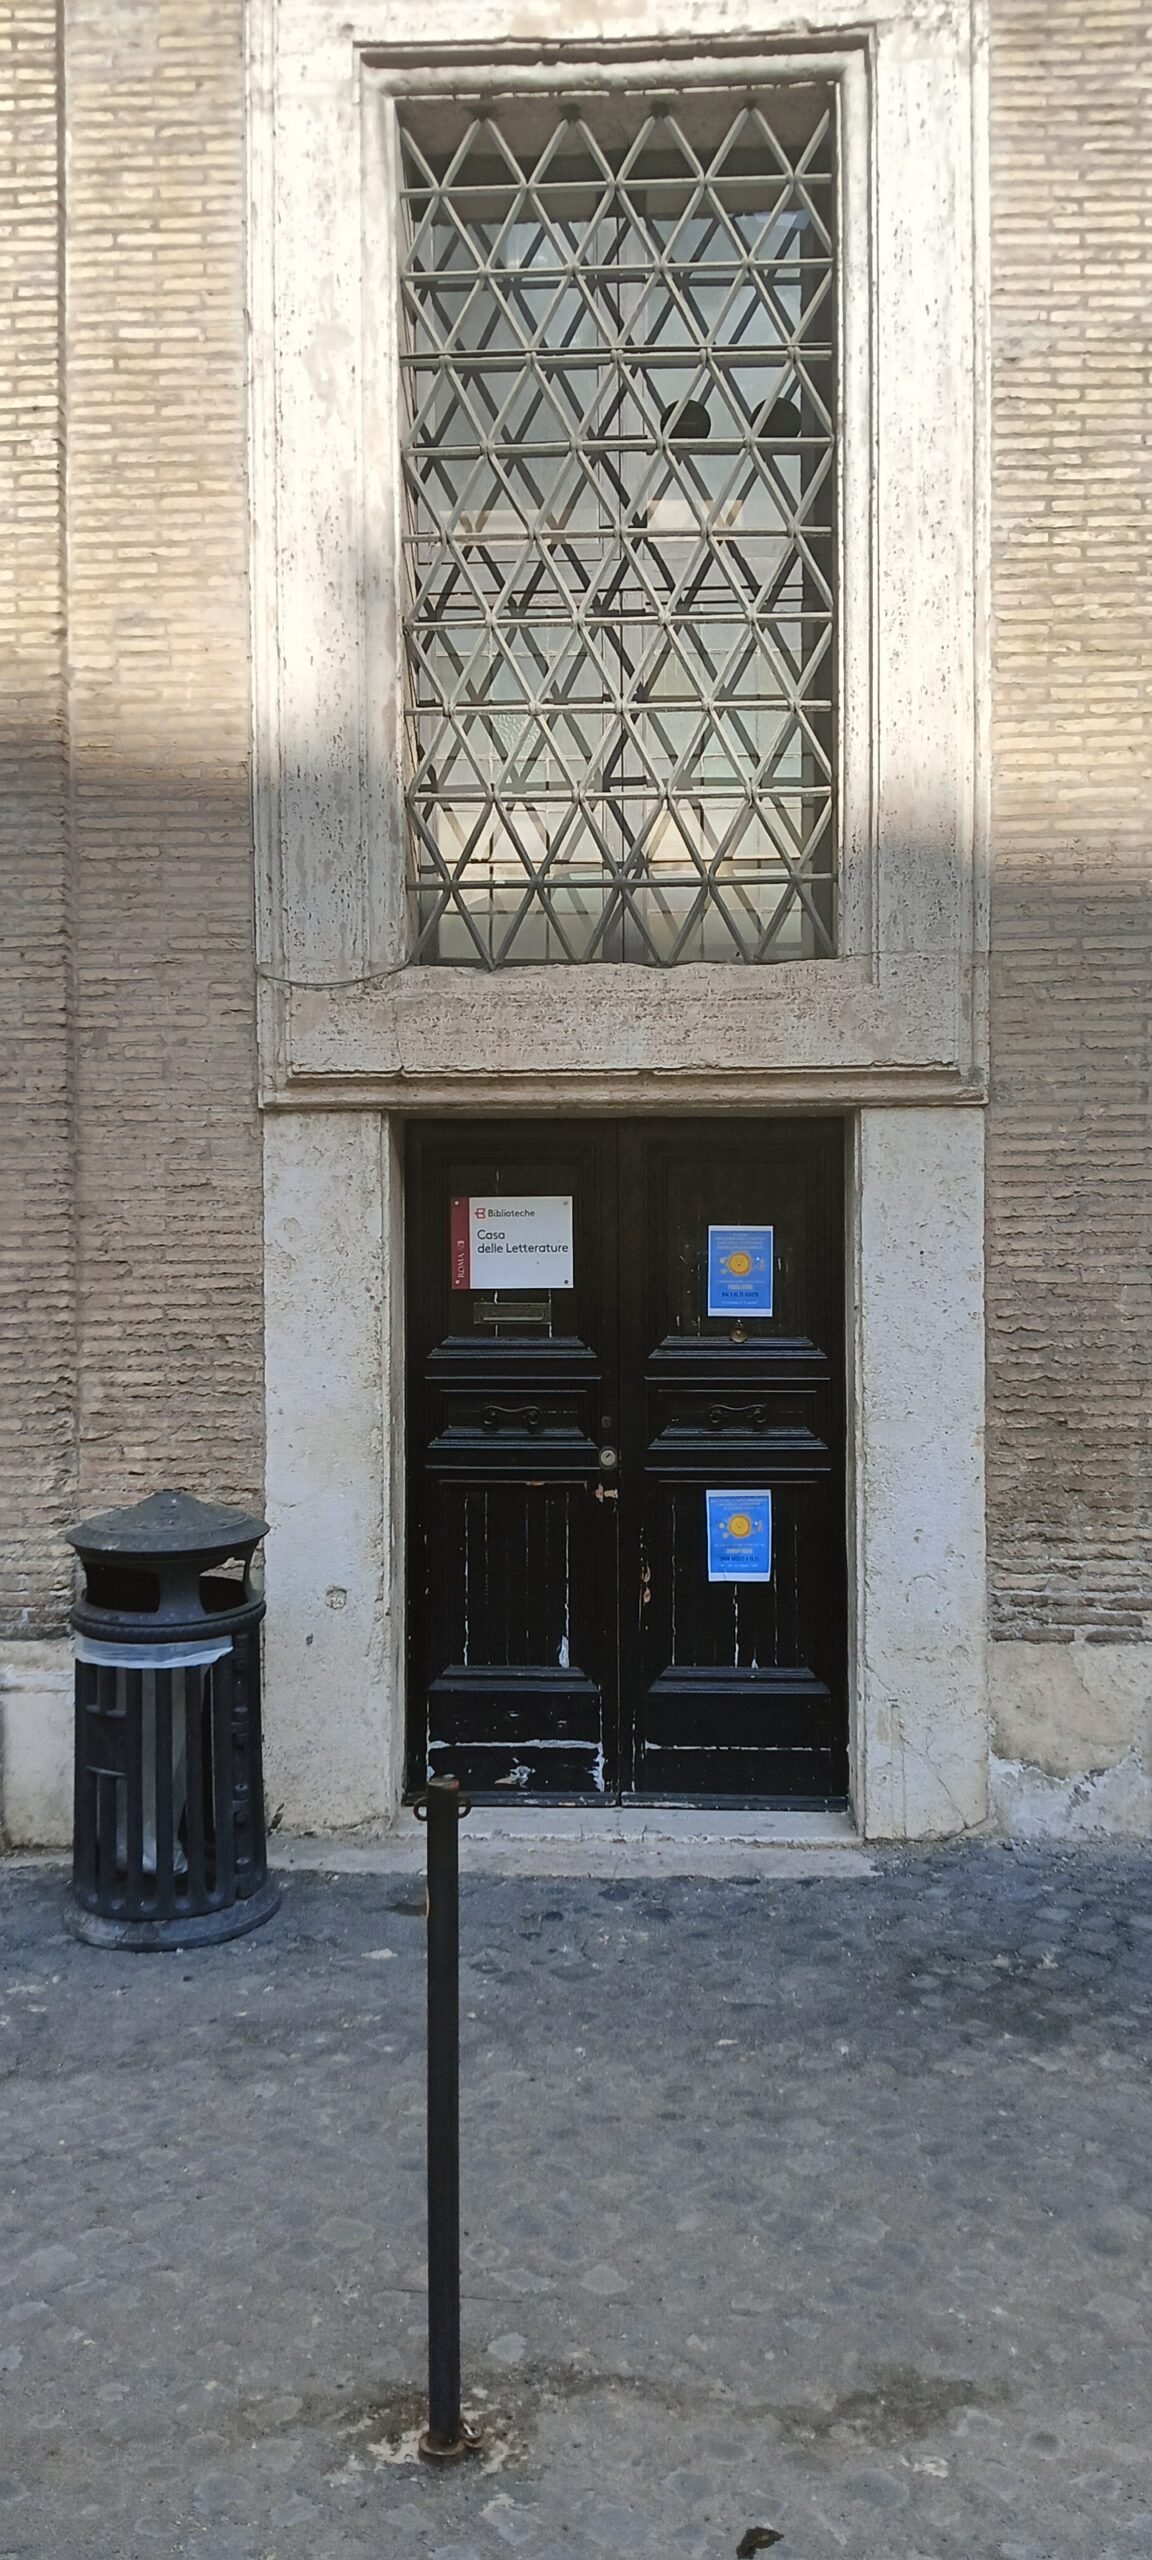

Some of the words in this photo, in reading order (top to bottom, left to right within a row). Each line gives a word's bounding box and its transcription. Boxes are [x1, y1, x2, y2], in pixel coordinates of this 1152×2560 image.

[487, 1209, 535, 1217] Biblioteche
[477, 1229, 505, 1240] Casa
[477, 1243, 503, 1253] delle
[506, 1243, 568, 1253] Letterature
[457, 1253, 465, 1278] ROMA
